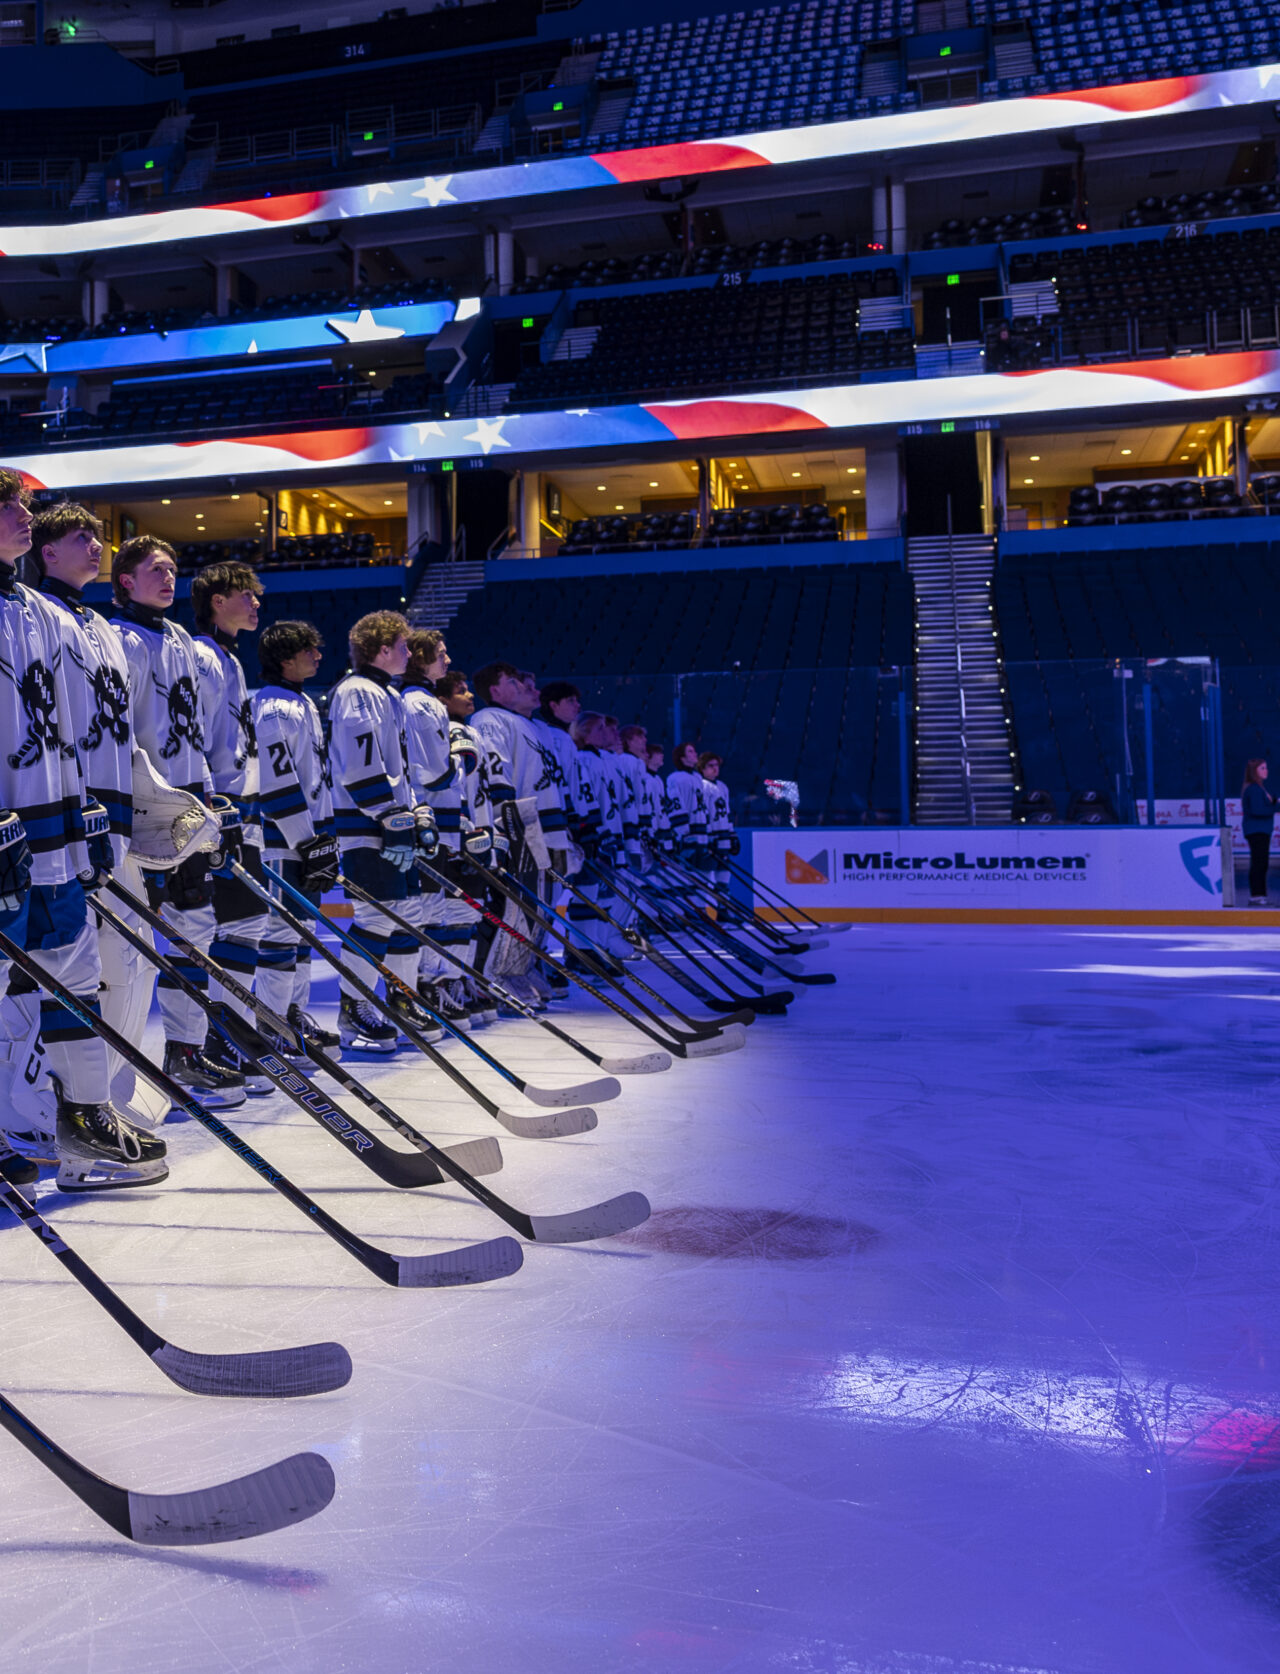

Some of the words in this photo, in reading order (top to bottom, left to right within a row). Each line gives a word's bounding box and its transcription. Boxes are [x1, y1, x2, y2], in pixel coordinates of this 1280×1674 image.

[344, 44, 365, 58] 314
[1174, 224, 1196, 238] 216
[722, 272, 741, 286] 215
[843, 852, 1086, 869] MicroLumen
[843, 872, 875, 881] HIGH
[880, 872, 970, 881] PERFORMANCE
[973, 872, 1028, 881] MEDICAL
[1033, 872, 1087, 881] DEVICES
[257, 1054, 371, 1159] BAUER
[185, 1101, 282, 1184] BAUER
